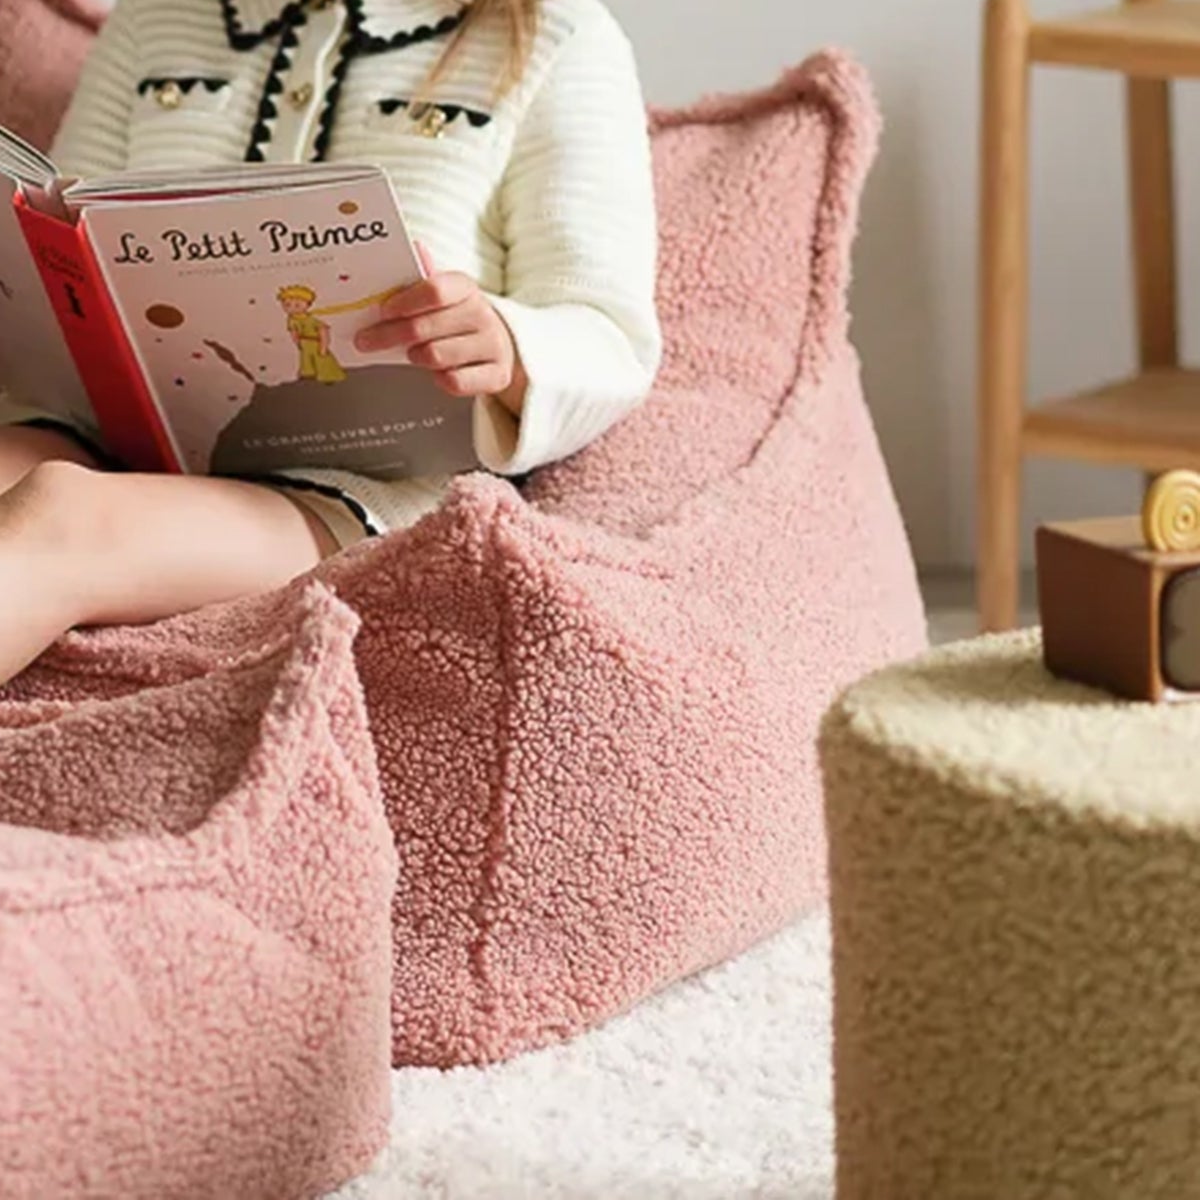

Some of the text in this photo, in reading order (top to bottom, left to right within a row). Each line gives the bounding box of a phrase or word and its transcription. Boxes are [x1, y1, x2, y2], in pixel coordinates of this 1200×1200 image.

[114, 220, 389, 263] Le Petit Prince
[330, 426, 377, 440] LIVRE
